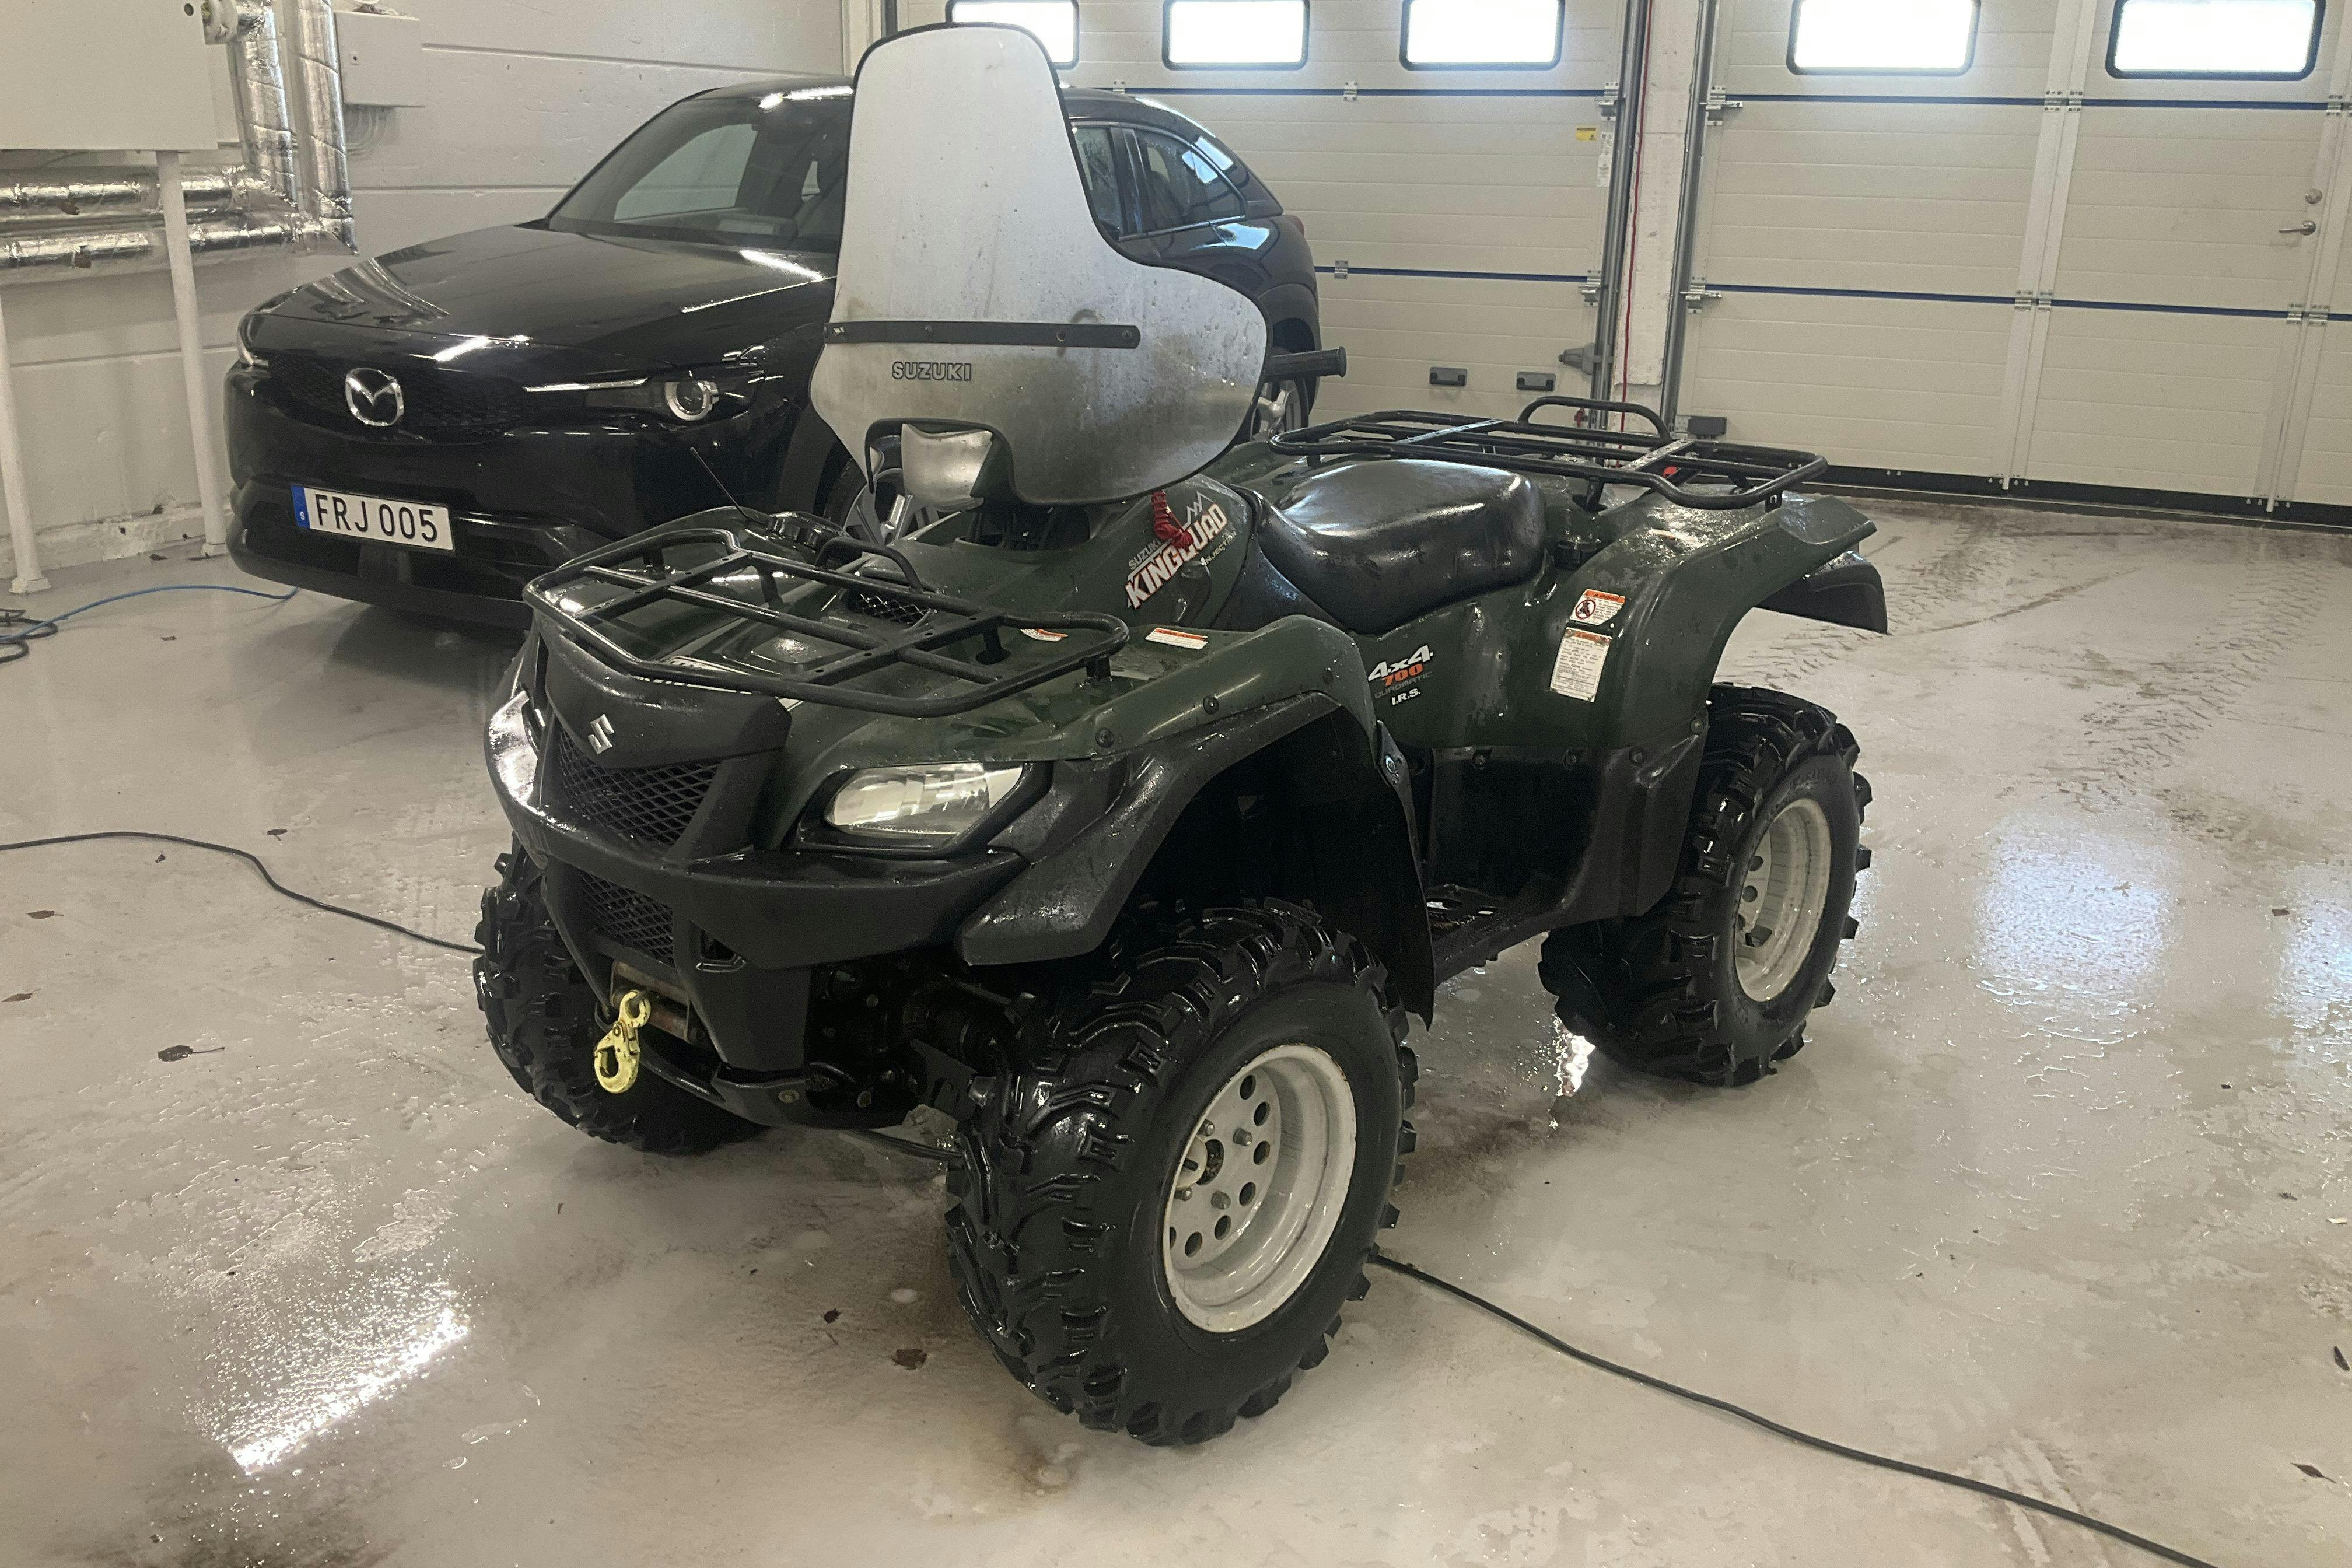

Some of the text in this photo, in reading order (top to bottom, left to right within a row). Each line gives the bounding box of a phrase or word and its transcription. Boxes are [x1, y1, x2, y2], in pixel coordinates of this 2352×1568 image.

[892, 361, 972, 381] SUZUKI
[300, 511, 306, 520] S
[315, 494, 438, 542] FRJ 005
[1128, 538, 1161, 570] SUZUKI
[1381, 663, 1423, 687] 700
